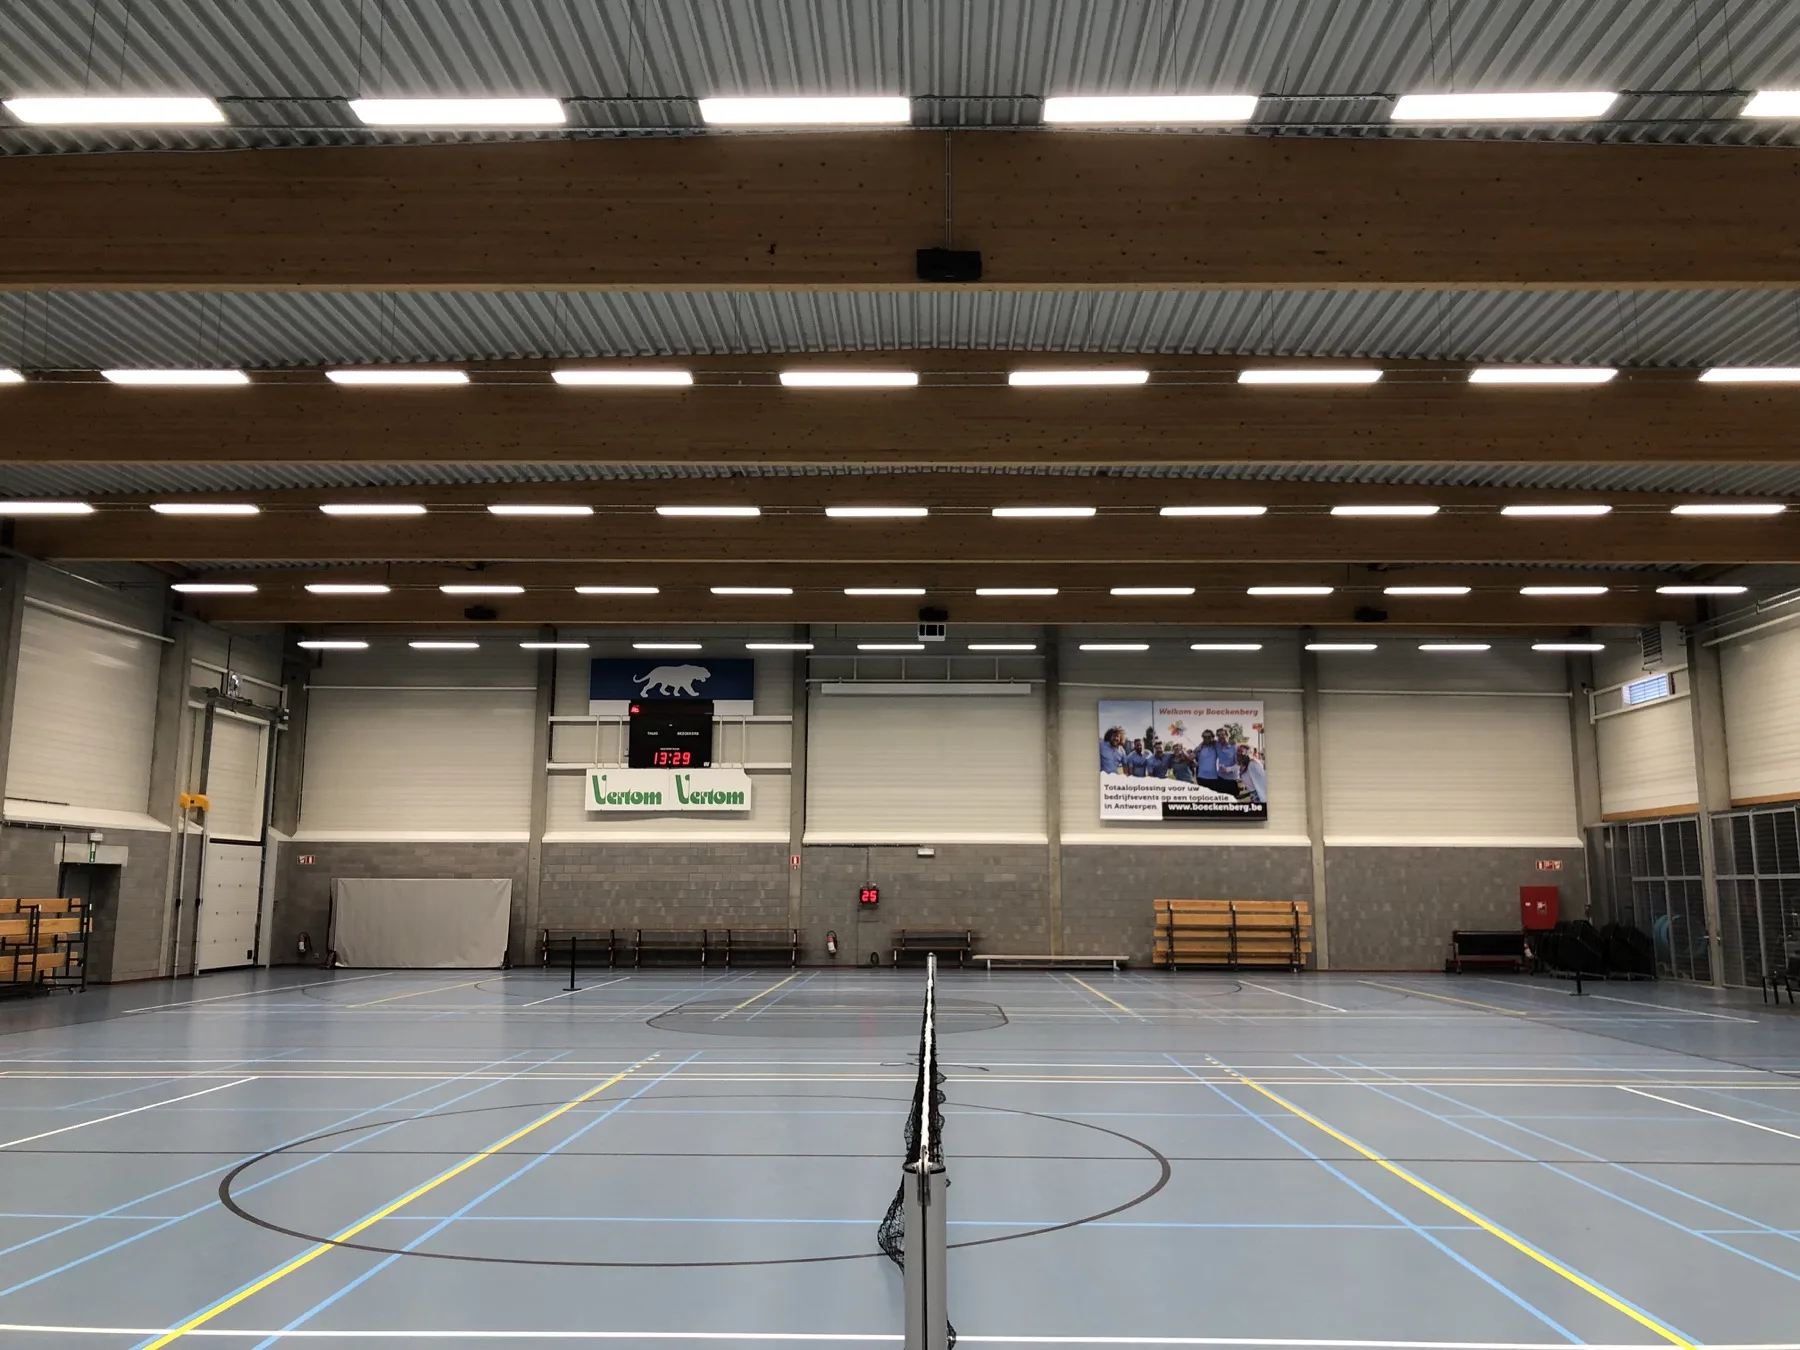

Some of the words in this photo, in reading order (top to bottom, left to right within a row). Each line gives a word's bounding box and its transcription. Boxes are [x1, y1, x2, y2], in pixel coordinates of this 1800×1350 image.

[1206, 708, 1259, 716] Boeckenberg
[654, 752, 691, 765] 13:29
[592, 774, 662, 805] Vertom
[675, 774, 745, 805] Vertom
[1104, 784, 1166, 792] Totaaloplossing
[1189, 794, 1229, 802] toplocatie
[1168, 803, 1262, 812] www.boeckenberg.be
[862, 890, 877, 902] 25
